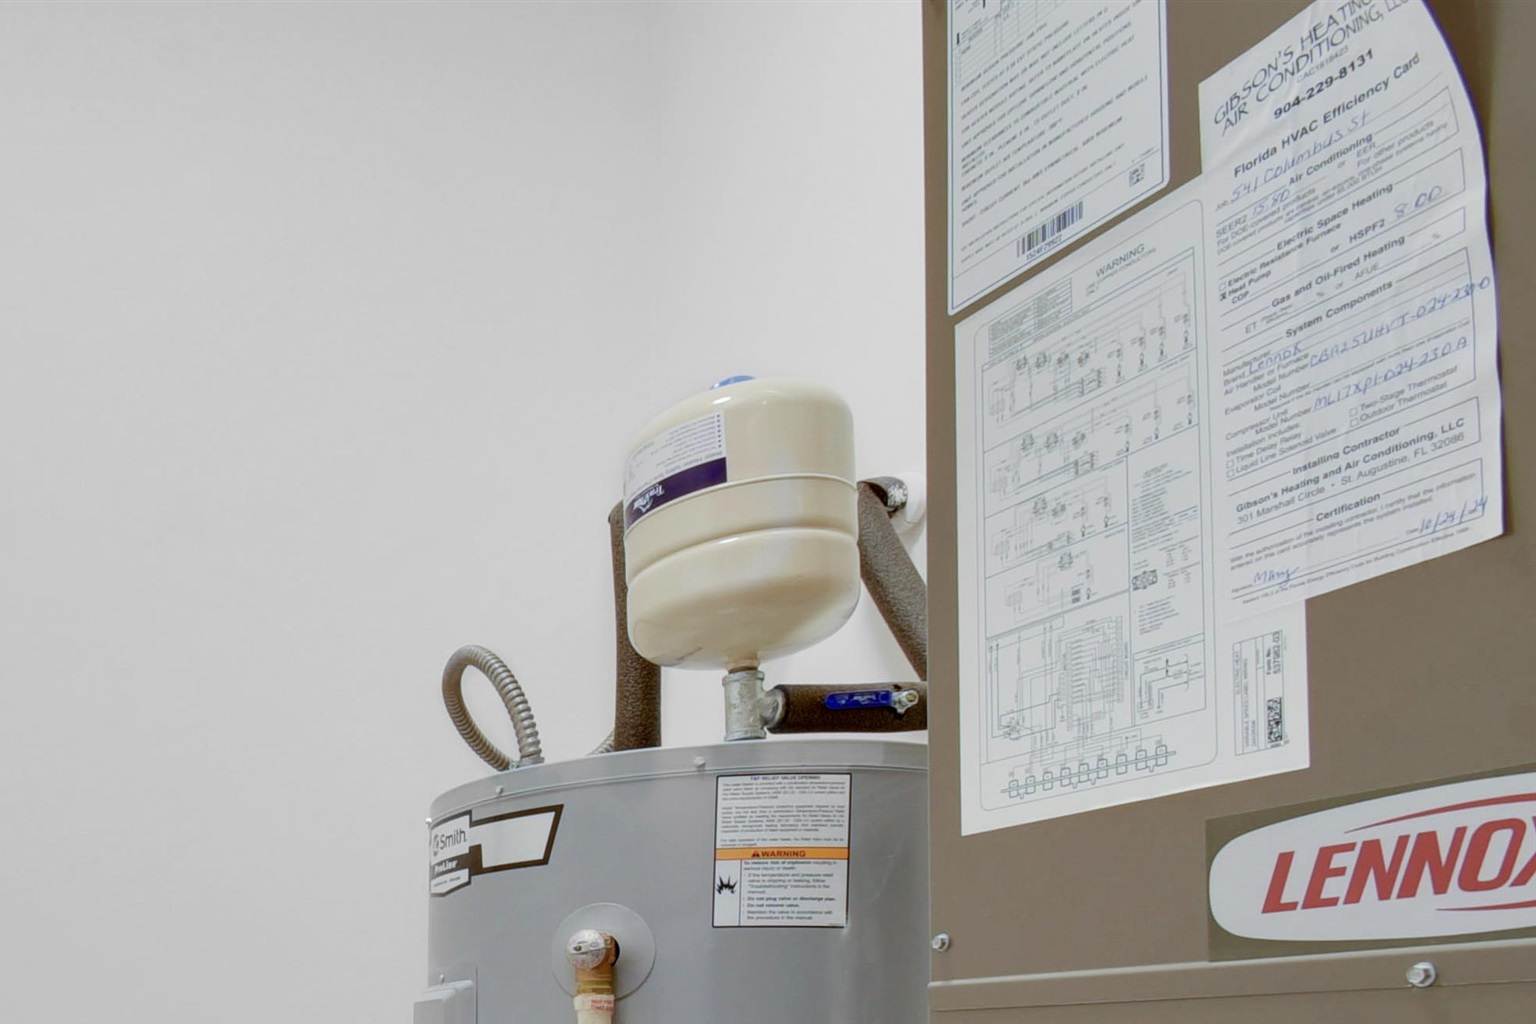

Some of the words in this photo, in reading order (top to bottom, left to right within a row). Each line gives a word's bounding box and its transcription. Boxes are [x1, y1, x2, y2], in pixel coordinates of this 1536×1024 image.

[1274, 48, 1373, 120] 904-229-8131
[1222, 102, 1249, 137] AIR
[1234, 143, 1276, 178] Florida
[1282, 117, 1318, 149] HVAC
[1323, 76, 1389, 125] Efficiency
[1394, 50, 1419, 80] Card
[1289, 171, 1302, 186] Air
[1306, 132, 1372, 176] Conditioning
[1277, 225, 1313, 251] Electric
[1317, 207, 1347, 230] Space
[1351, 182, 1393, 211] Heating
[1349, 216, 1384, 244] HSPF2
[1095, 244, 1145, 278] WARNING
[1248, 268, 1271, 286] Pump
[1271, 293, 1289, 308] Gas
[1293, 279, 1311, 296] and
[1315, 256, 1359, 285] Oil-Fired
[1364, 235, 1404, 261] Heating
[1285, 315, 1322, 339] System
[1325, 279, 1391, 319] Components
[1279, 362, 1309, 381] Number
[1236, 491, 1277, 514] Gibson's
[1281, 475, 1318, 496] Heating
[1323, 464, 1340, 479] and
[1344, 458, 1359, 471] Air
[1363, 429, 1436, 464] Conditioning,
[1441, 417, 1464, 434] LLC
[1292, 451, 1339, 474] Installing
[1343, 427, 1399, 455] Contractor
[1256, 494, 1294, 518] Marshall
[1297, 485, 1324, 502] Circle
[1316, 491, 1380, 522] Certification
[440, 828, 466, 850] Smith
